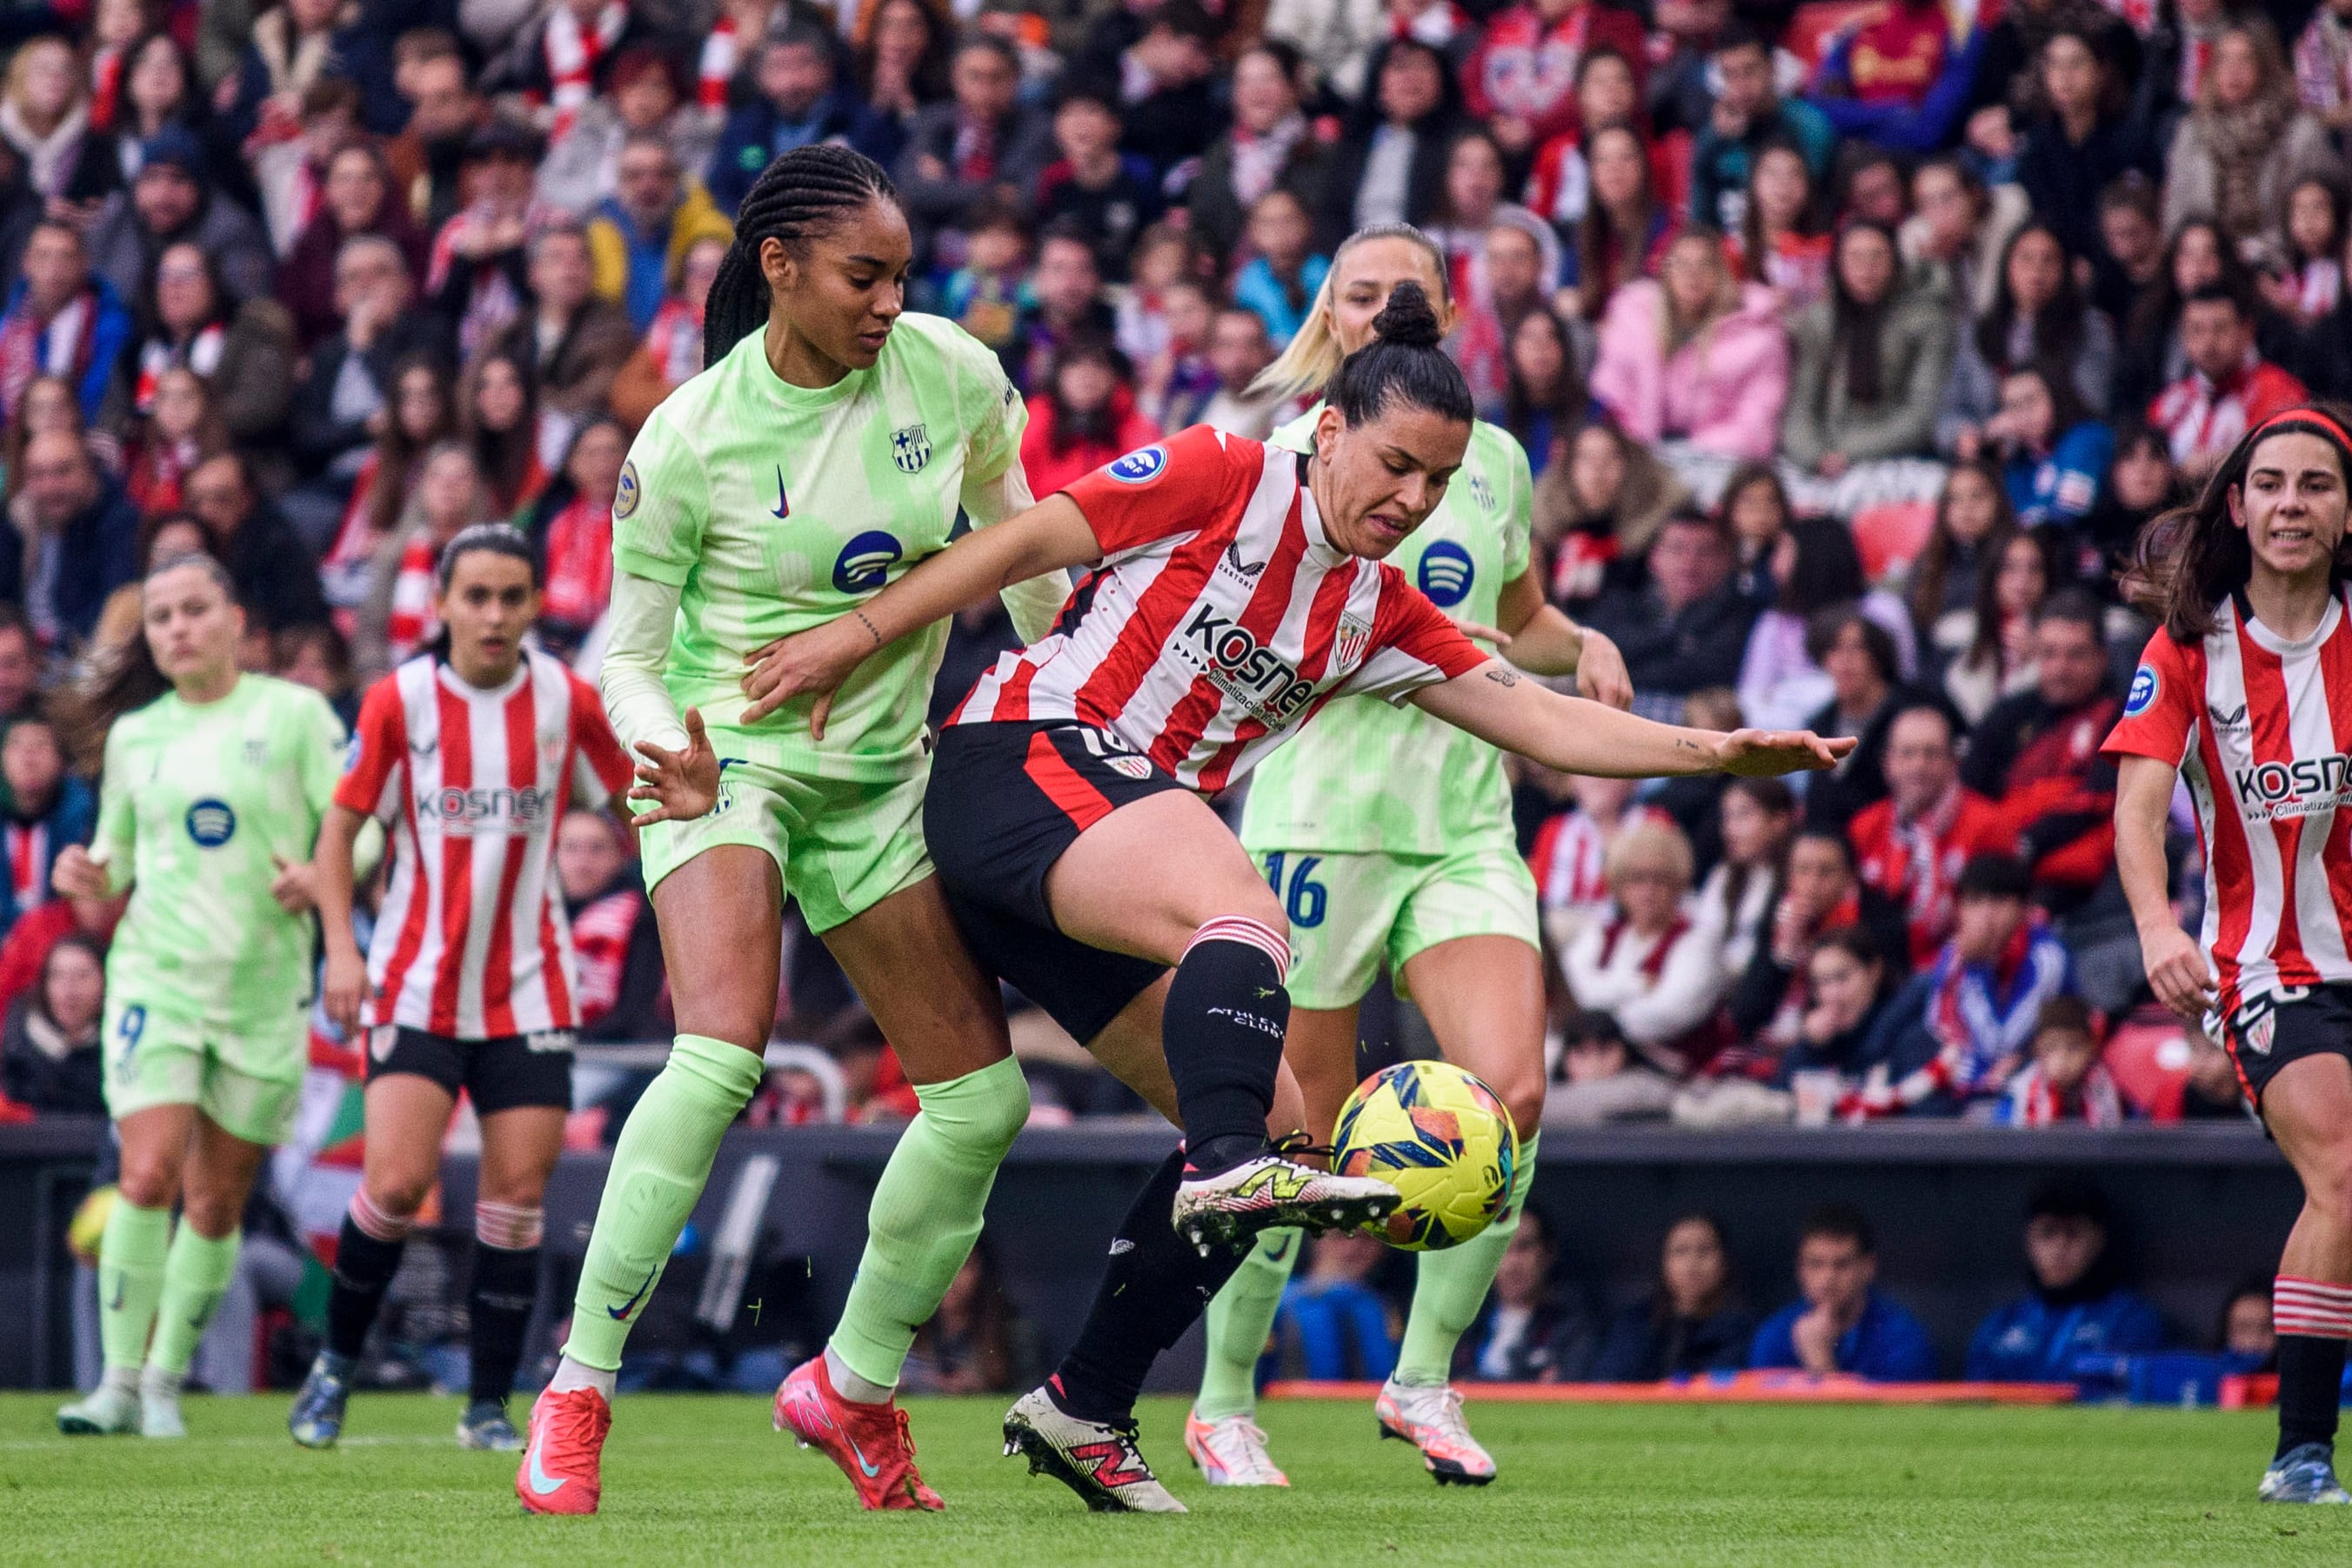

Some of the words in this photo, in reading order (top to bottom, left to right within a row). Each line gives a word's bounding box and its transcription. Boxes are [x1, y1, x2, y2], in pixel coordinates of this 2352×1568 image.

[1219, 564, 1253, 591] CASTORE
[1265, 851, 1327, 928] 16
[117, 1003, 146, 1057] 9
[1234, 1016, 1280, 1038] CLUB
